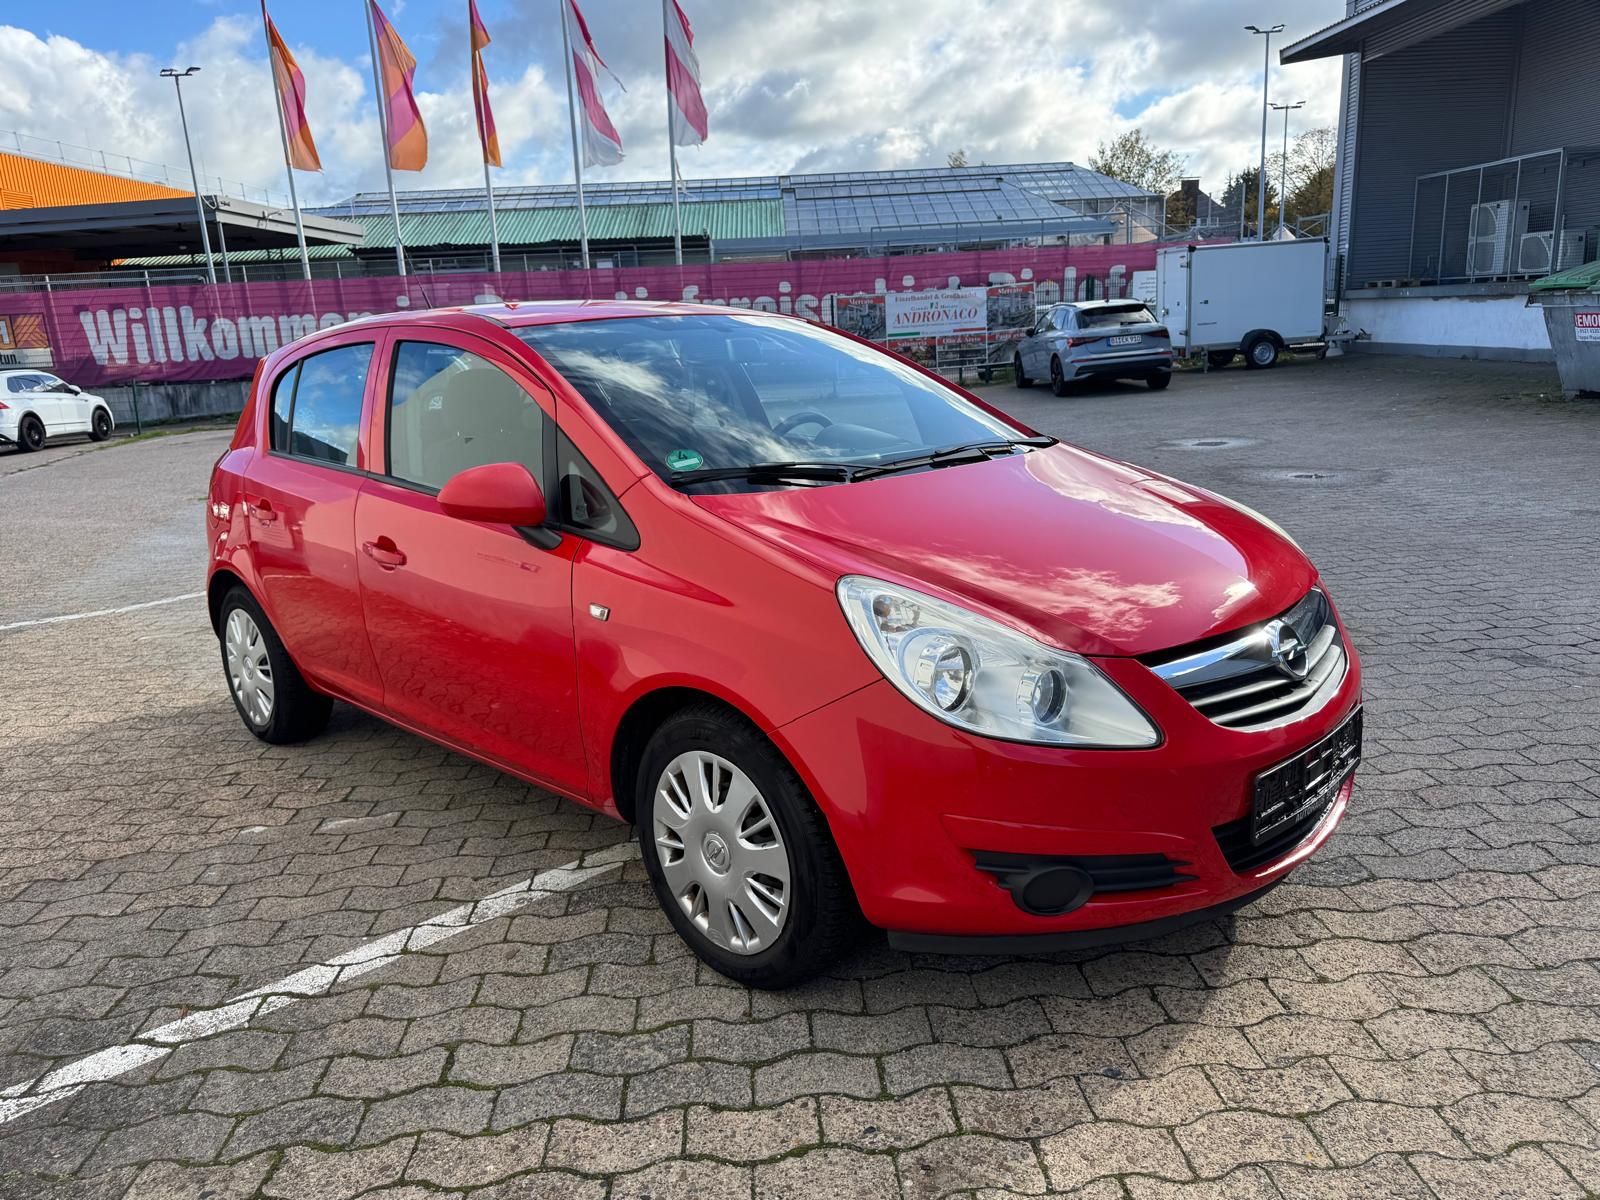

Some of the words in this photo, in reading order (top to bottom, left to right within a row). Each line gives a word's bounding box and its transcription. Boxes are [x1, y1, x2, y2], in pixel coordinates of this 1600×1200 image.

[895, 293, 933, 302] Einzelhandel
[893, 307, 978, 325] ANDRONACO
[678, 450, 688, 460] 4
